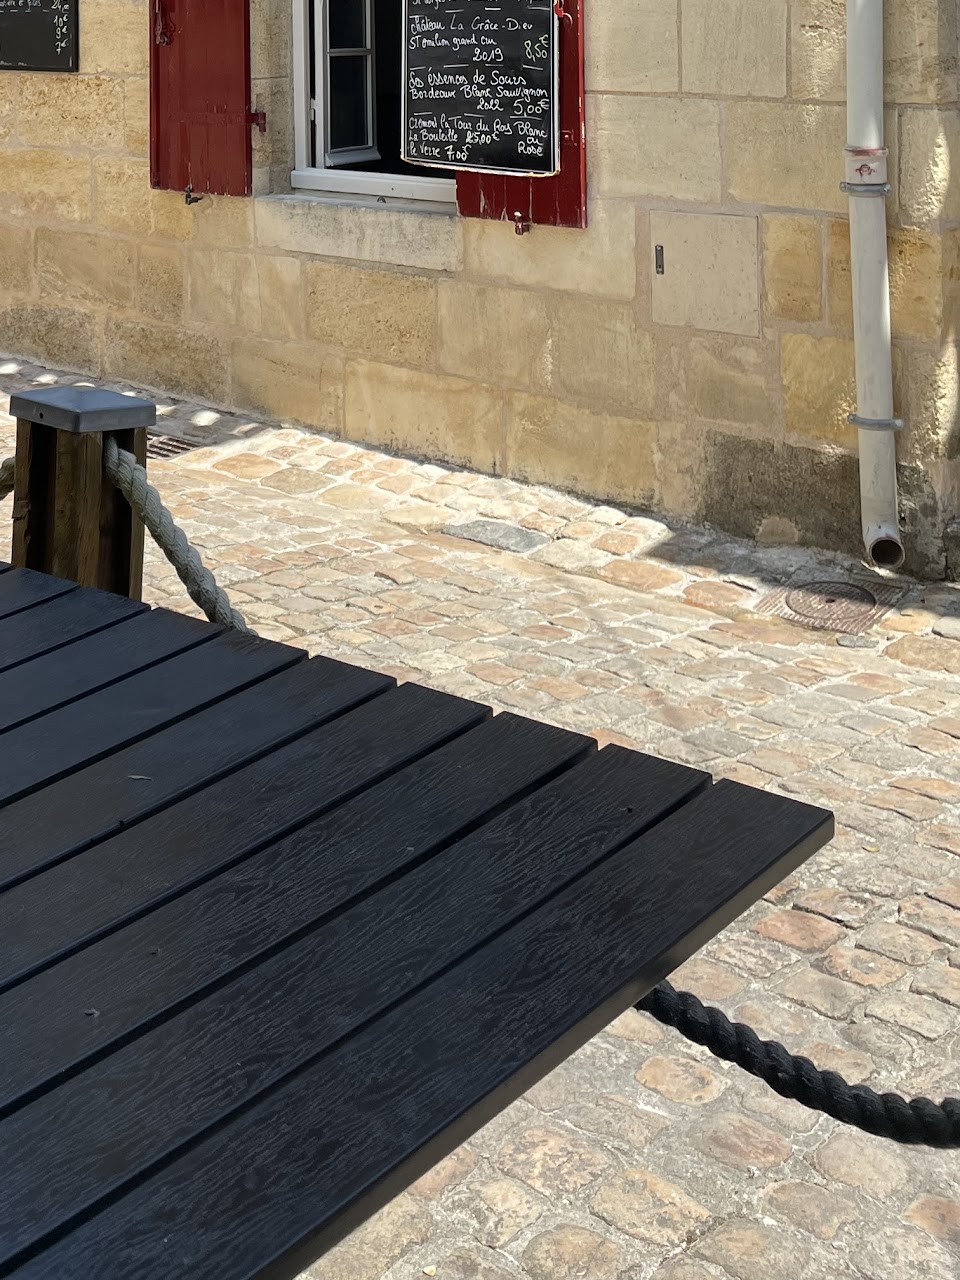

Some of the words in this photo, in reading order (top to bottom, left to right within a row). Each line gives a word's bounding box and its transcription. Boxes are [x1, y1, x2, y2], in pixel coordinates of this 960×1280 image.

[450, 14, 464, 30] La
[453, 34, 478, 51] grand
[473, 48, 503, 62] 2019
[473, 69, 486, 84] de
[409, 86, 456, 100] Bordeaux
[459, 85, 493, 99] Blanc
[477, 98, 504, 111] 2022
[420, 129, 458, 141] Bouteille
[476, 119, 489, 131] du
[493, 119, 512, 135] Roy
[513, 122, 548, 138] Blanc
